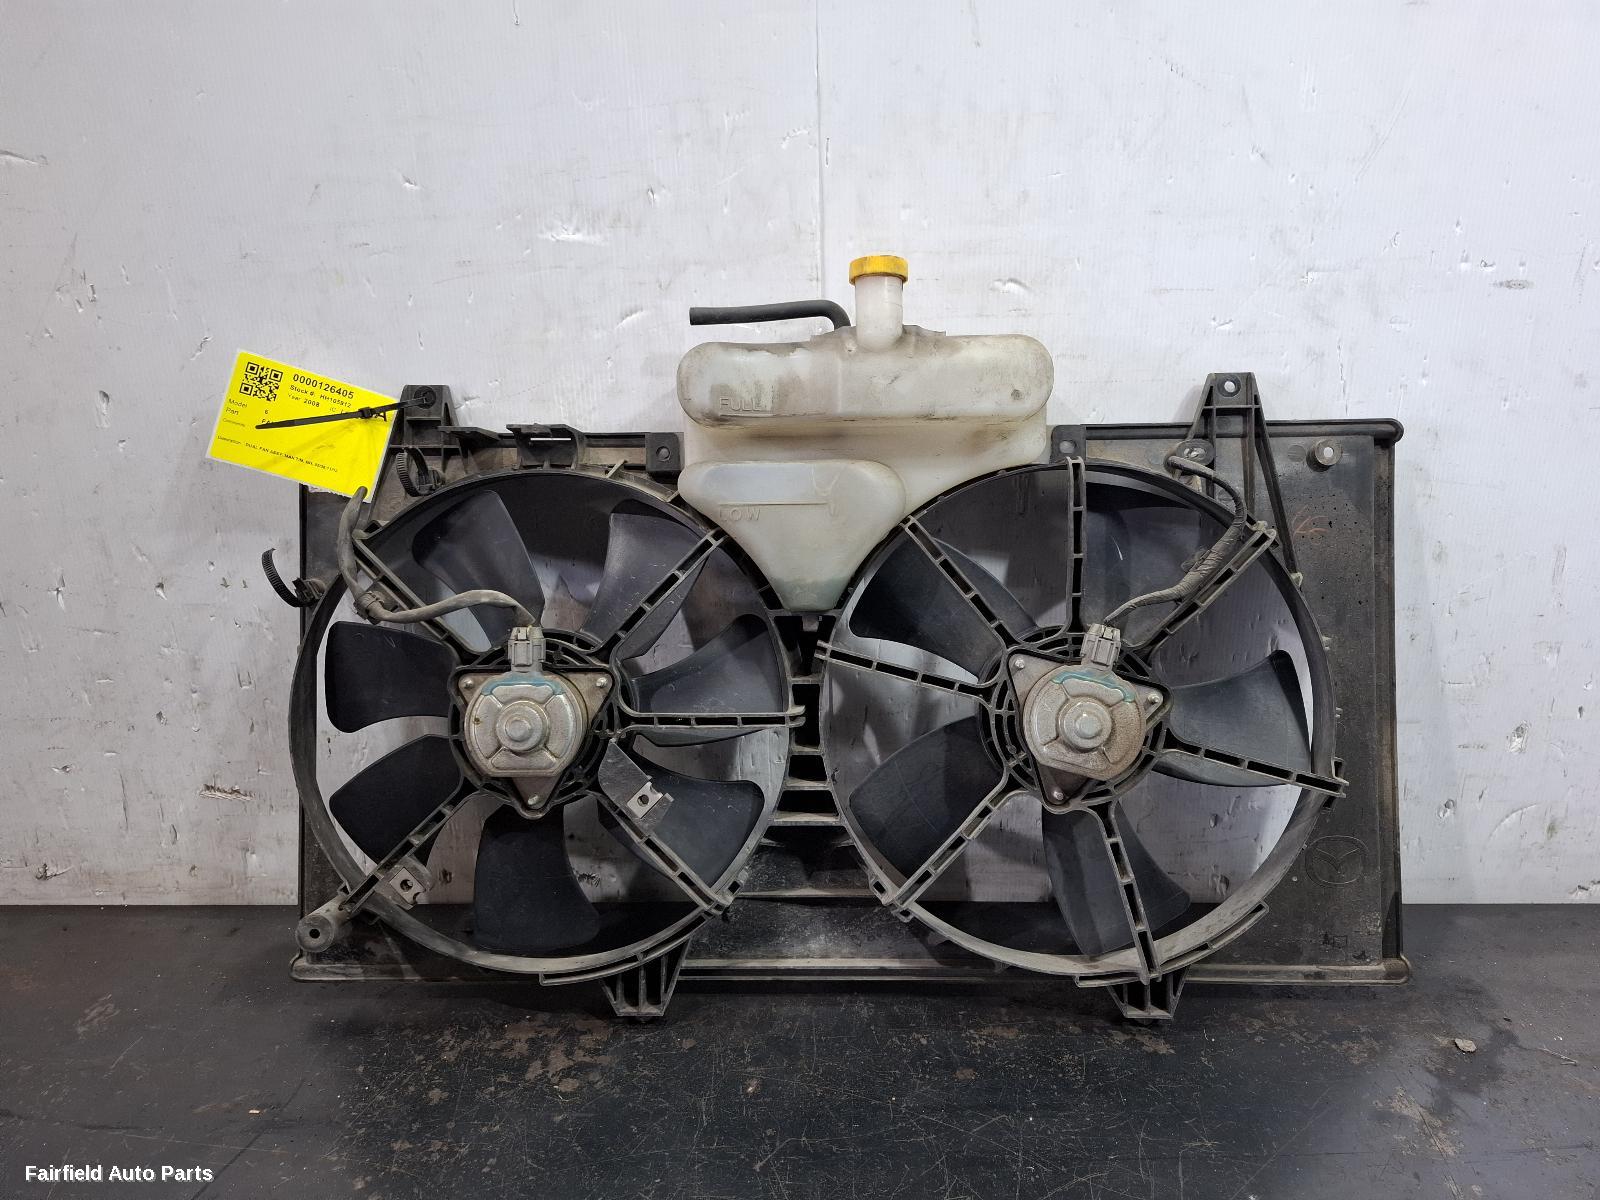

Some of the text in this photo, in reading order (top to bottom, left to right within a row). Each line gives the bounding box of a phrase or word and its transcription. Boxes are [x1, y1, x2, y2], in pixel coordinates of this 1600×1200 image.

[289, 384, 309, 396] Stock
[292, 373, 355, 400] 0000126405
[303, 397, 321, 408] 2008
[719, 397, 761, 412] FULL
[719, 507, 761, 522] LOW
